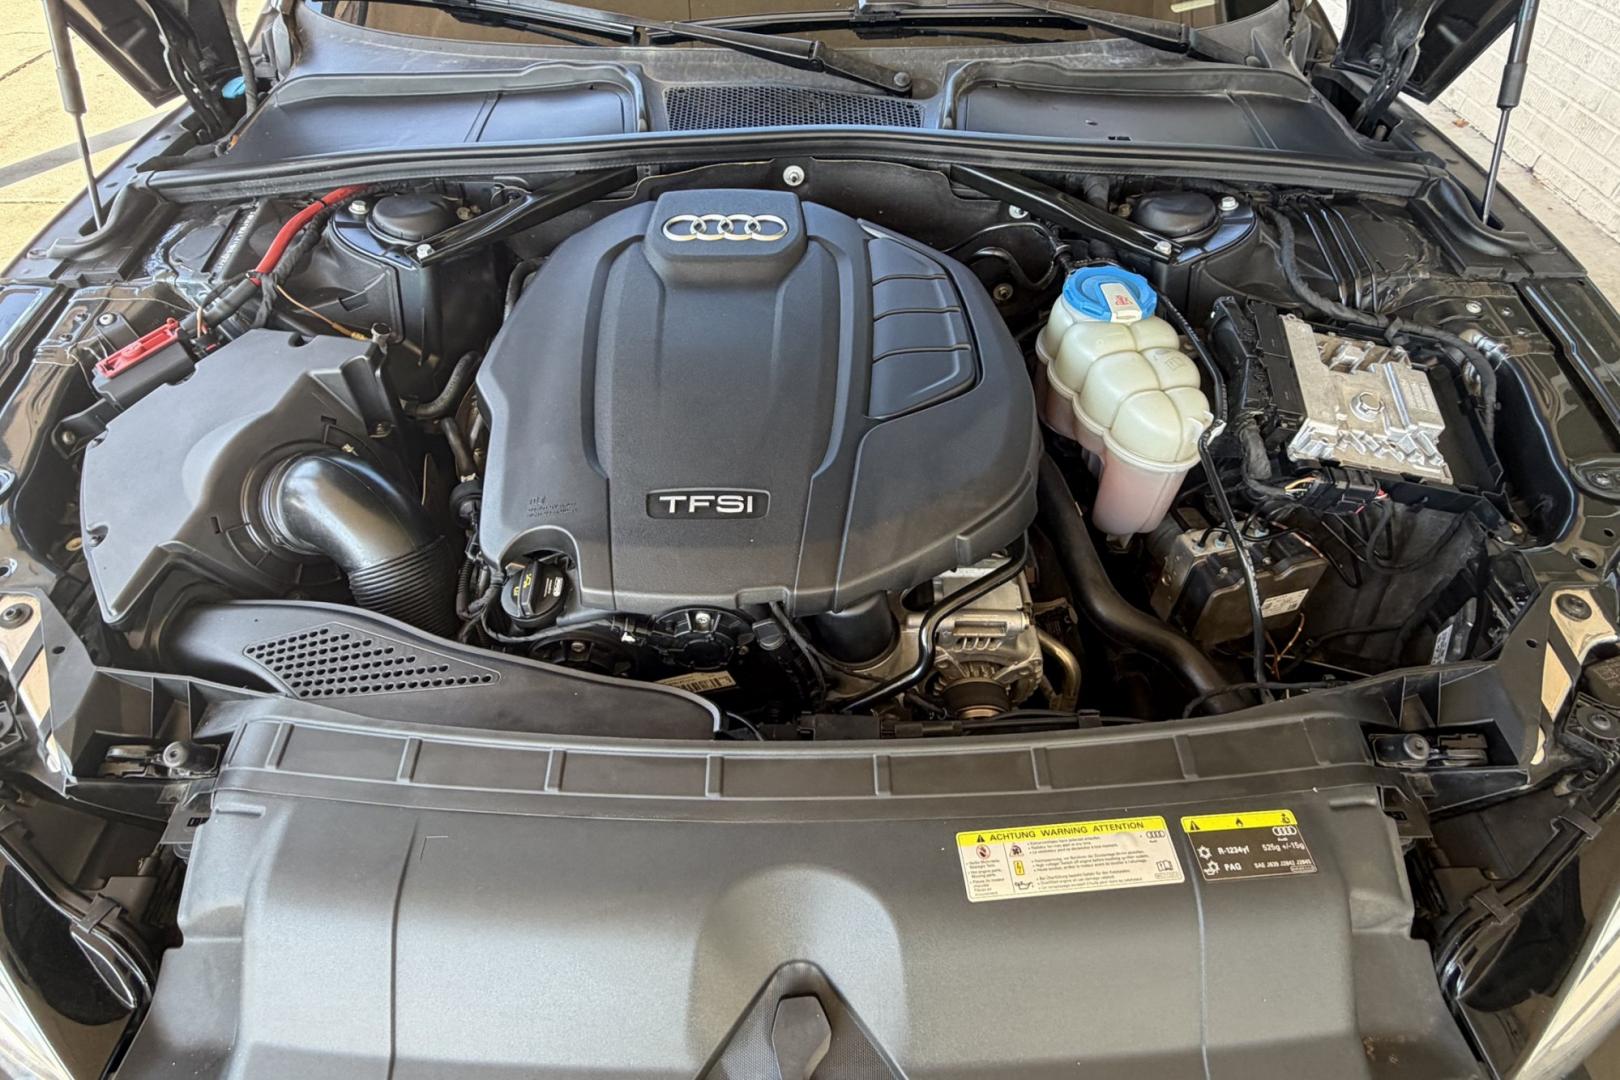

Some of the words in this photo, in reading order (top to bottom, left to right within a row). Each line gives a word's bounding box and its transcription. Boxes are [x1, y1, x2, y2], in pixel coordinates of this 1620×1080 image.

[659, 495, 753, 514] TFSI
[990, 830, 1036, 841] ACHTUNG
[1040, 825, 1088, 837] WARNING
[1093, 822, 1144, 832] ATTENTION
[1217, 845, 1250, 855] R-1234yf
[1224, 862, 1242, 872] PAG
